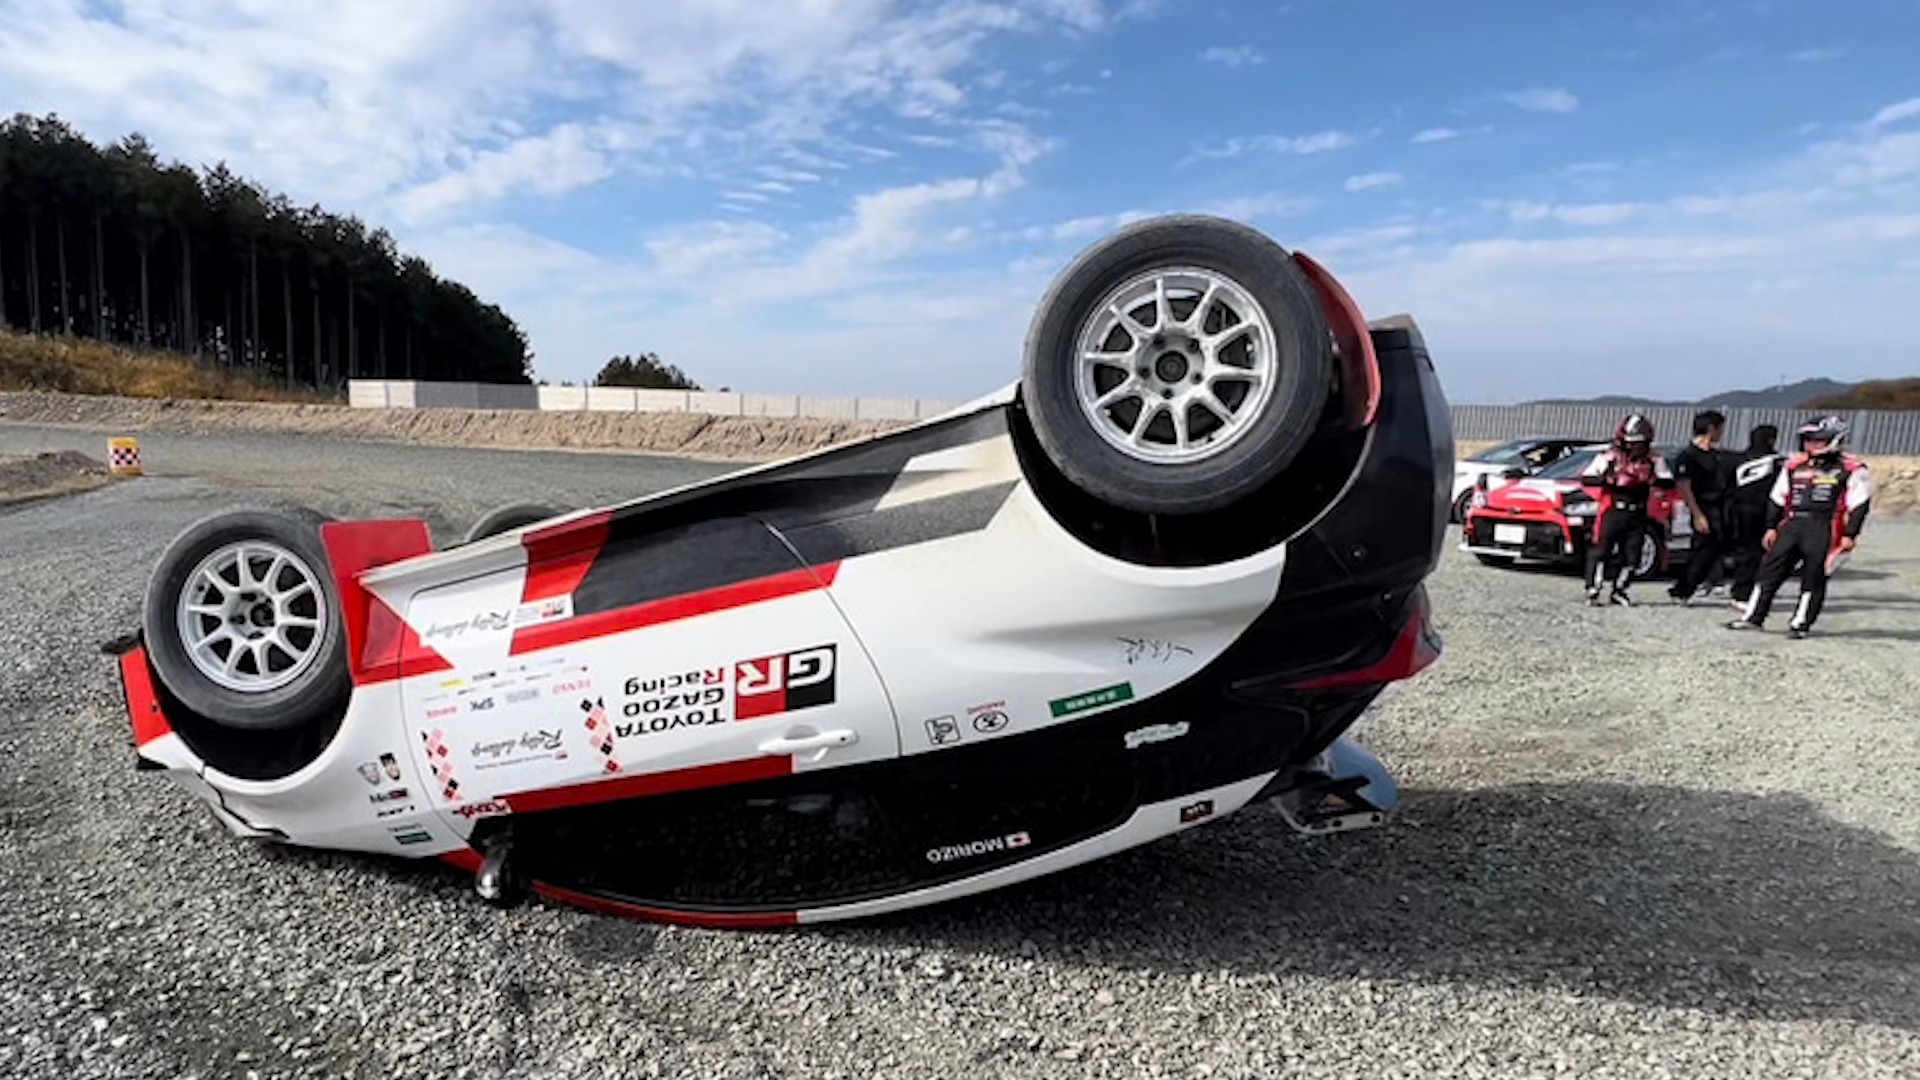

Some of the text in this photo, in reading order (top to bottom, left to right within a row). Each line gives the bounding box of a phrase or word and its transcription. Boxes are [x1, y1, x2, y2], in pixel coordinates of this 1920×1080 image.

[624, 667, 725, 698] Racing
[736, 645, 836, 699] GR
[623, 688, 725, 718] GAZOO
[614, 706, 726, 738] TOYOTA
[926, 837, 1005, 864] MORIZO
